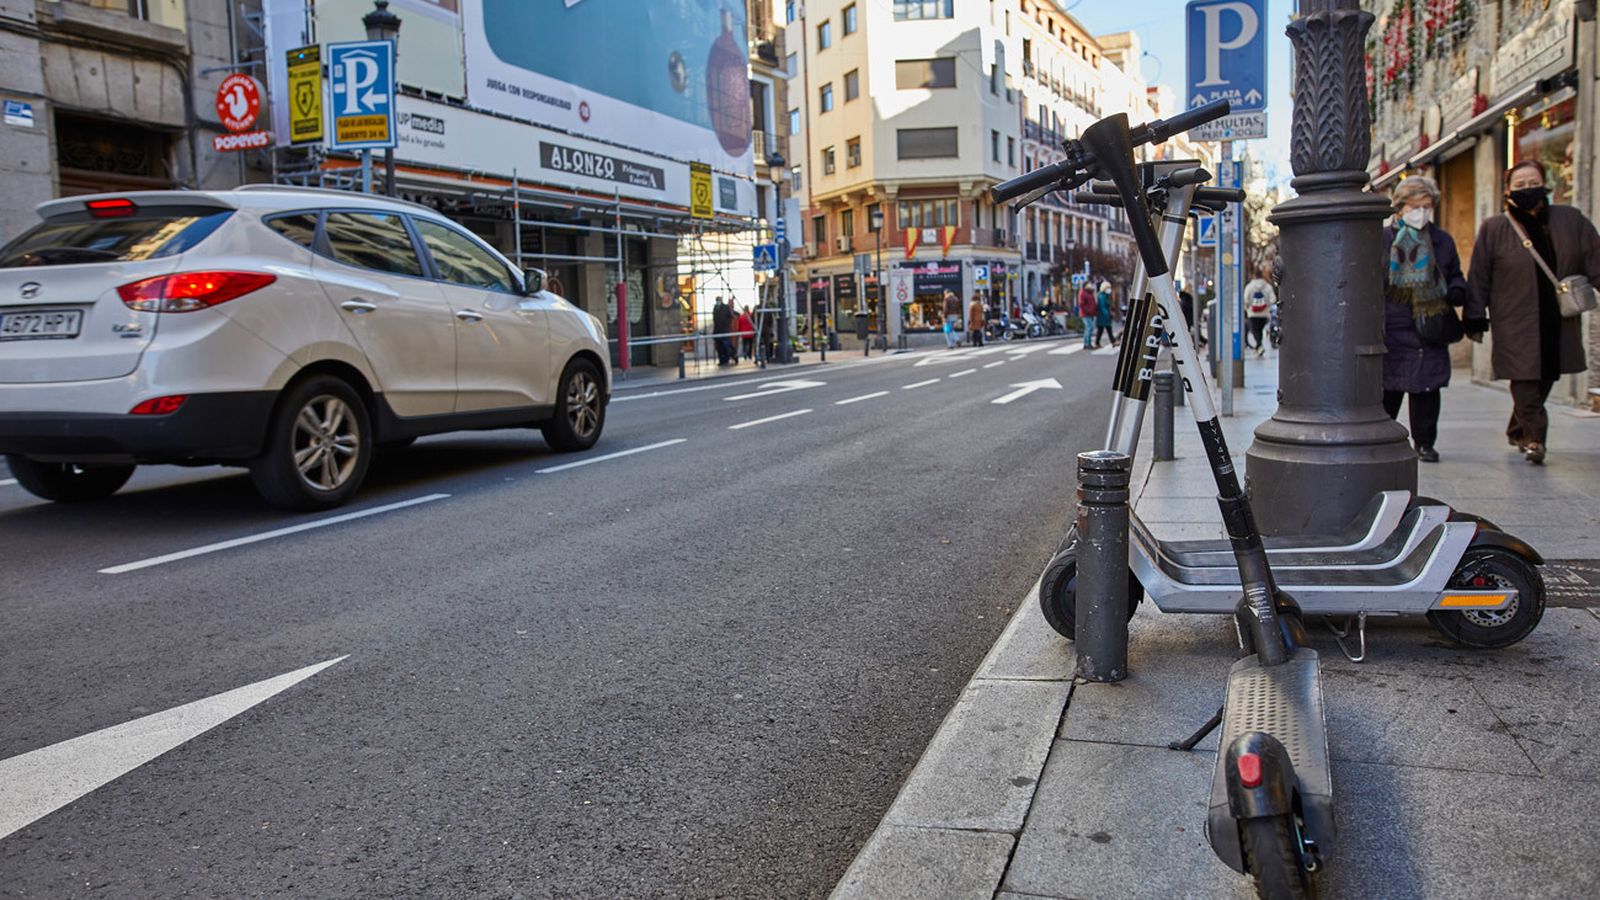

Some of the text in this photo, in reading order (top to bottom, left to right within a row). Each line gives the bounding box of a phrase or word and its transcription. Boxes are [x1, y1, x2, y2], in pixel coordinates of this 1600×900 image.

[1195, 2, 1259, 87] P
[341, 57, 379, 114] P
[1138, 314, 1164, 381] BIRD
